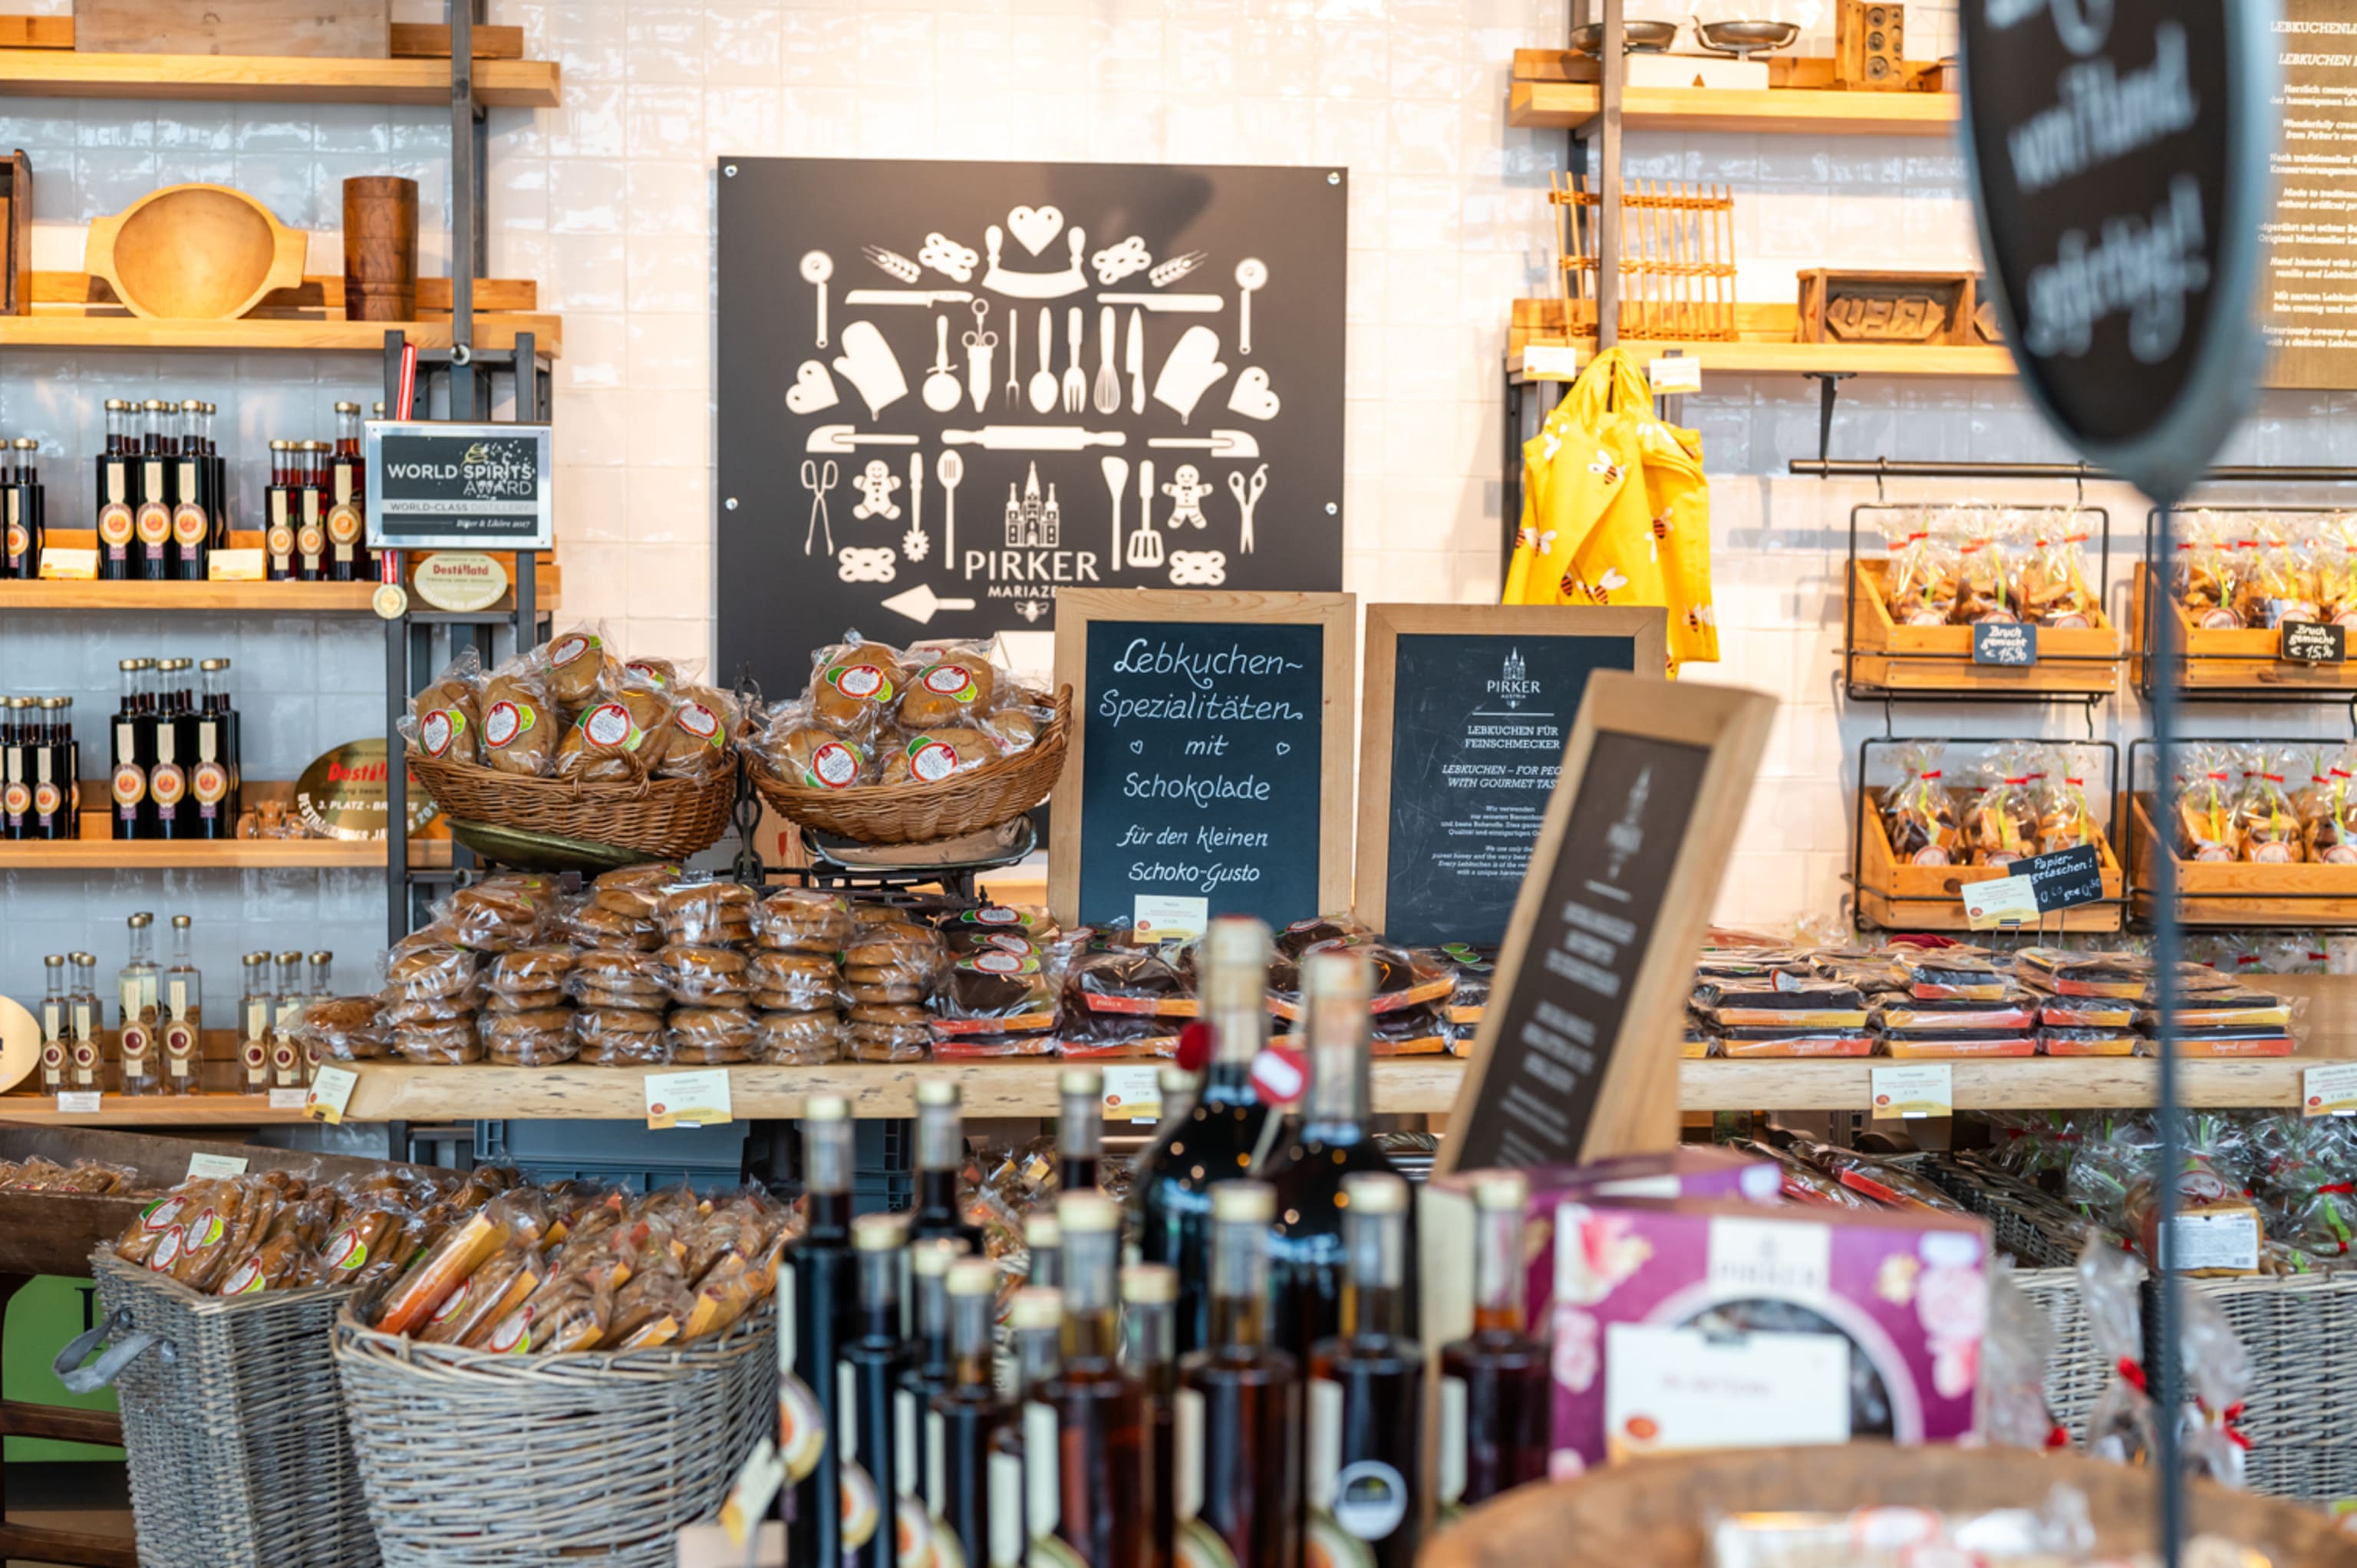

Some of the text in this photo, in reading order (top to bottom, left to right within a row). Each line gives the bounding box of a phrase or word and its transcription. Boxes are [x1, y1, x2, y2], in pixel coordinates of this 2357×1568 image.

[2278, 54, 2351, 66] LEBKUCHEN
[387, 463, 532, 479] WORLD SPIRITS
[463, 480, 532, 496] AWARD
[391, 502, 529, 512] WORLD-CLASS DISTILLERY
[965, 551, 1100, 581] PIRKER
[987, 585, 1073, 598] MARIAZE
[1487, 680, 1541, 693] PIRKER
[1099, 689, 1304, 727] Spezialitäten
[1467, 726, 1558, 736] LEBKUCHEN FÜR
[1185, 735, 1229, 756] mit
[1465, 739, 1560, 749] FEINSCHMECKER
[1442, 764, 1506, 775] LEBKUCHEN
[1516, 766, 1538, 775] FOR
[1541, 766, 1563, 776] PEO
[1123, 772, 1271, 808] Schokolade
[1448, 777, 1559, 789] WITH GOURMET TAS
[330, 802, 364, 811] PLATZ
[1116, 824, 1268, 853] für den kleinen
[2034, 855, 2073, 871] Papier-
[1129, 862, 1261, 892] Schoko-Gusto
